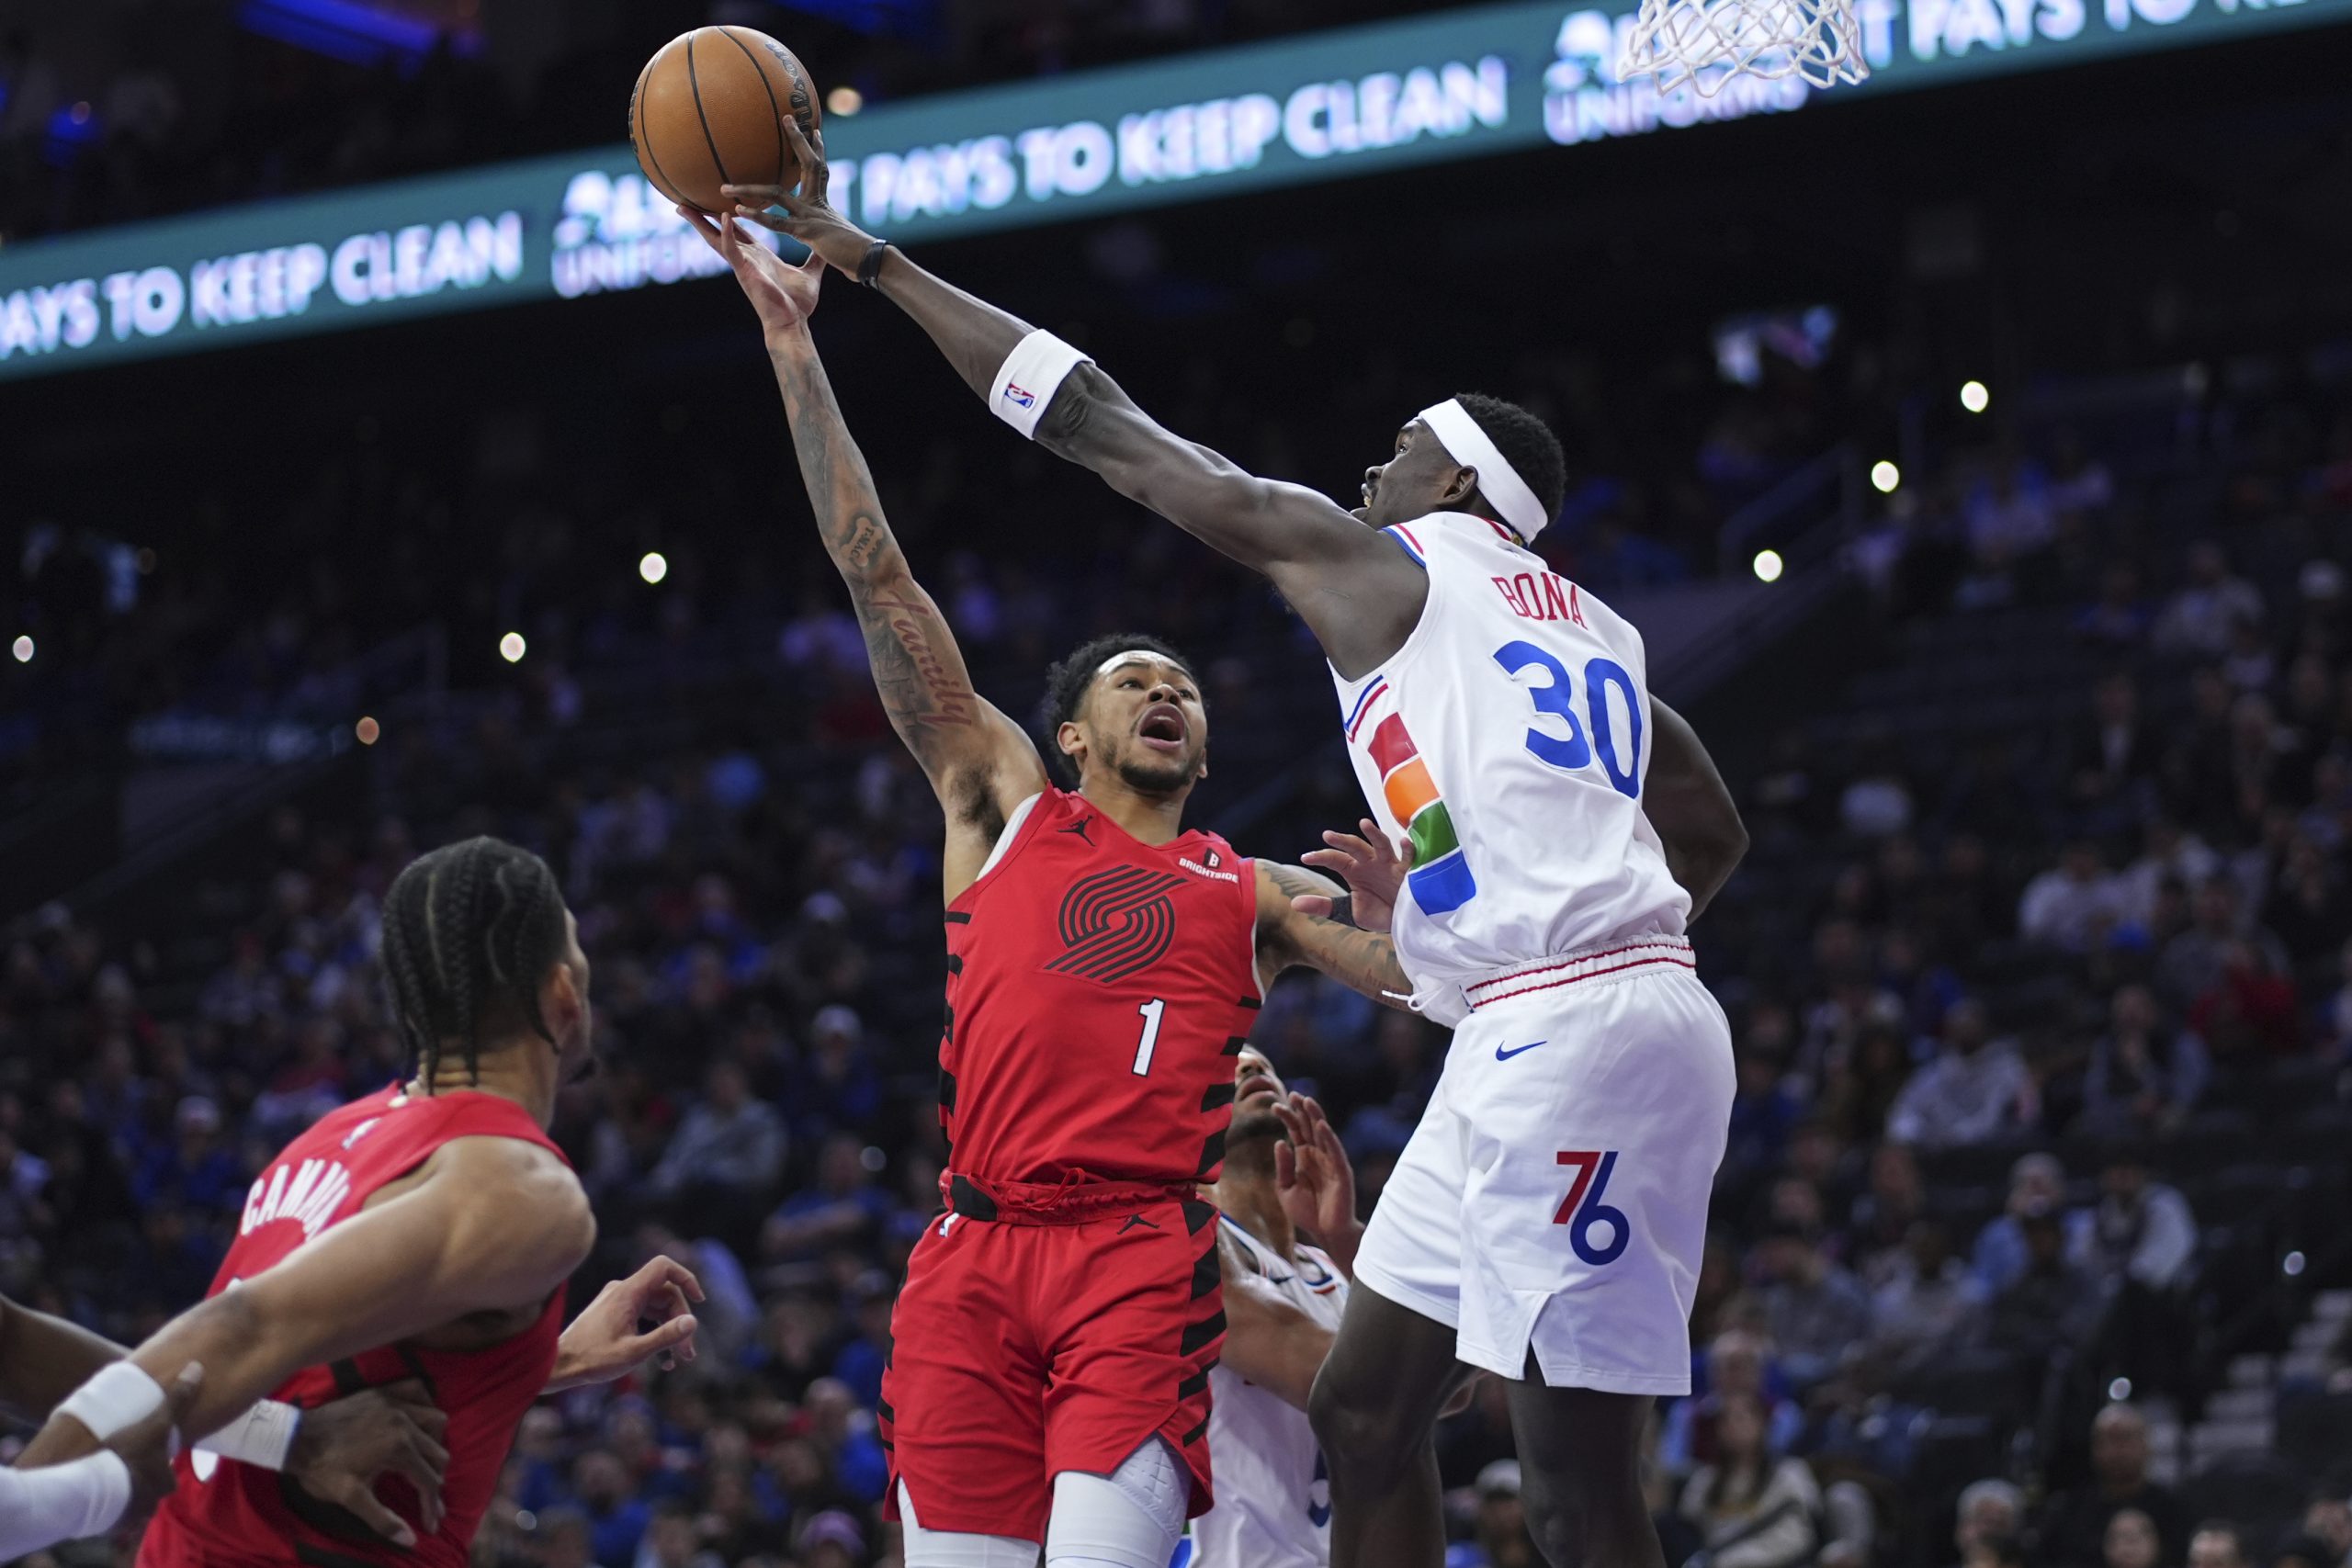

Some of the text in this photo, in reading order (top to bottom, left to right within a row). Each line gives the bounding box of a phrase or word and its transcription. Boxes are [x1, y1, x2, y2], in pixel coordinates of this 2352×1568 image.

[861, 135, 1017, 227] PAYS
[1017, 121, 1114, 201] TO
[1118, 93, 1281, 186] KEEP
[1284, 55, 1508, 159] CLEAN
[0, 210, 525, 361] AYS TO KEEP CLEAN
[550, 218, 780, 299] UNIFOR
[1490, 571, 1589, 631] BONA
[1492, 639, 1643, 800] 30
[1179, 857, 1238, 883] BRIGHTSIDE
[1131, 997, 1166, 1077] 1
[1552, 1150, 1631, 1267] 76
